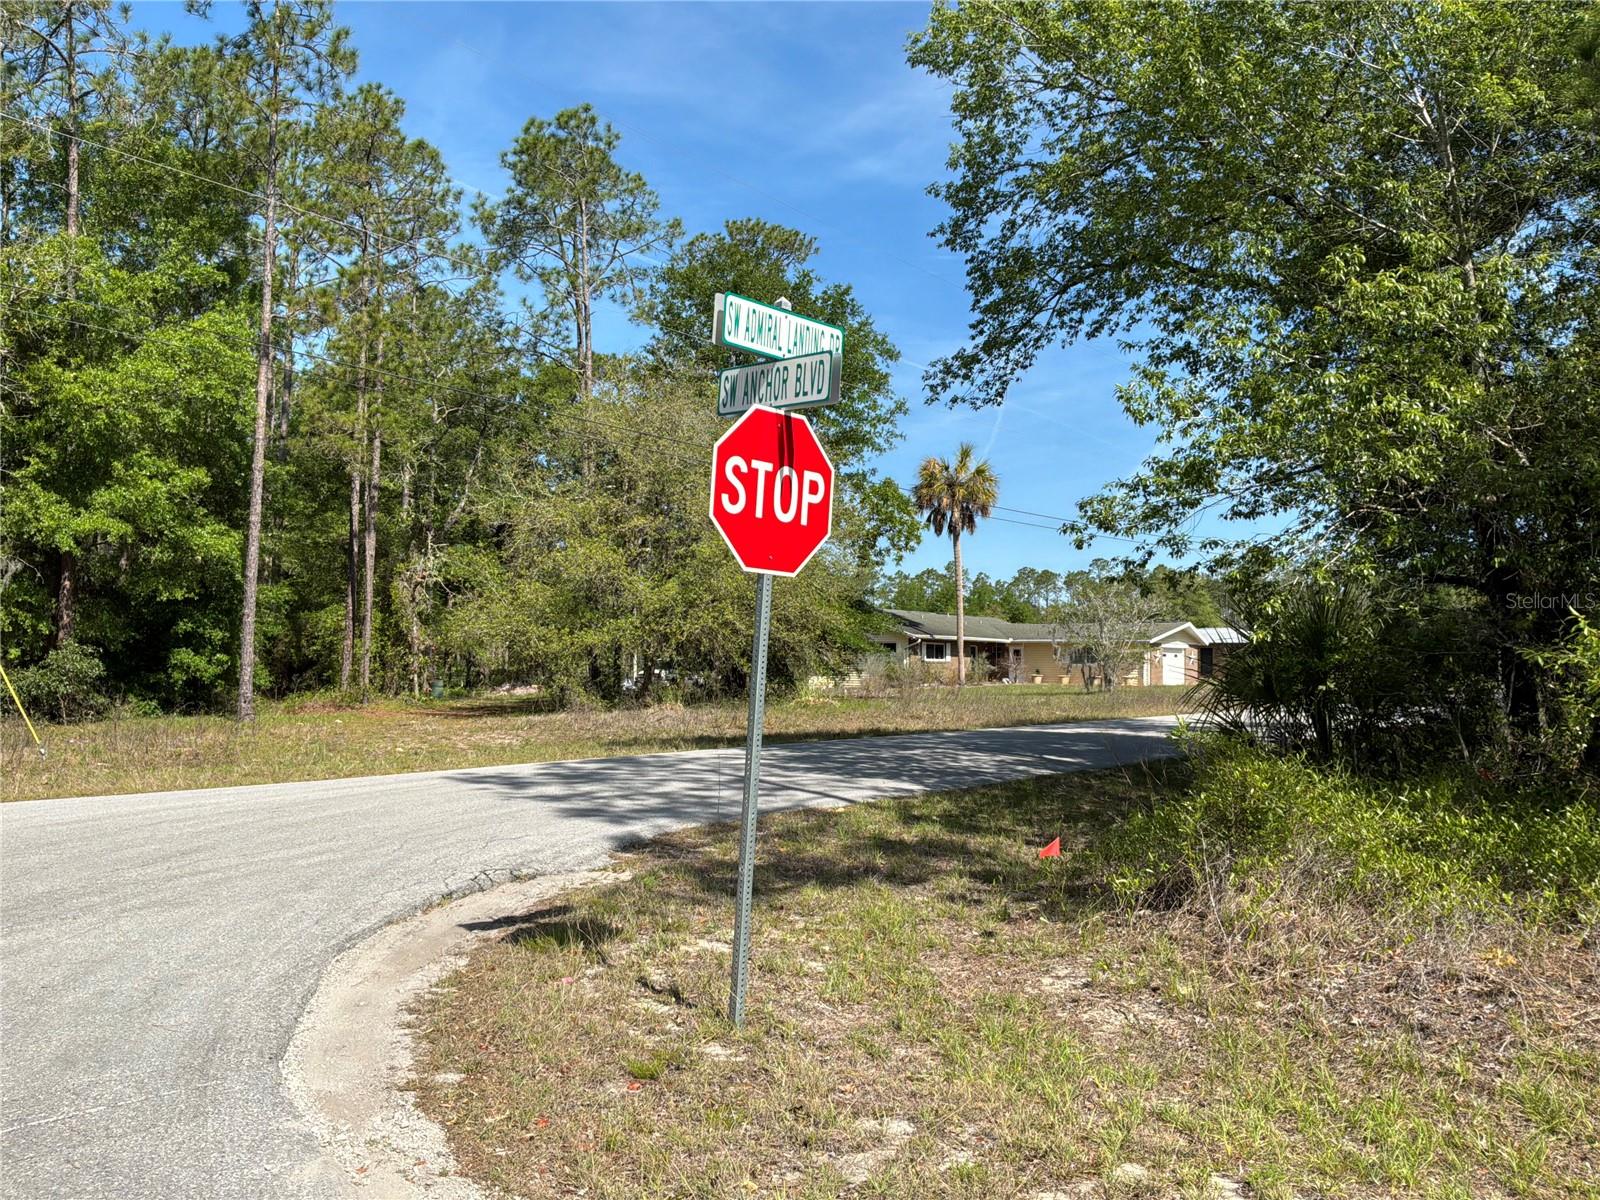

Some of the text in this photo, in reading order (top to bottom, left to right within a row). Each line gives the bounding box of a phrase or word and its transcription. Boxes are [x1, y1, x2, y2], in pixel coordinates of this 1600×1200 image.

[727, 301, 741, 339] SW
[744, 308, 783, 351] ADMIRAL
[787, 319, 825, 355] LANDING
[722, 359, 825, 408] SW ANCHOR BLVD
[720, 455, 826, 527] STOP
